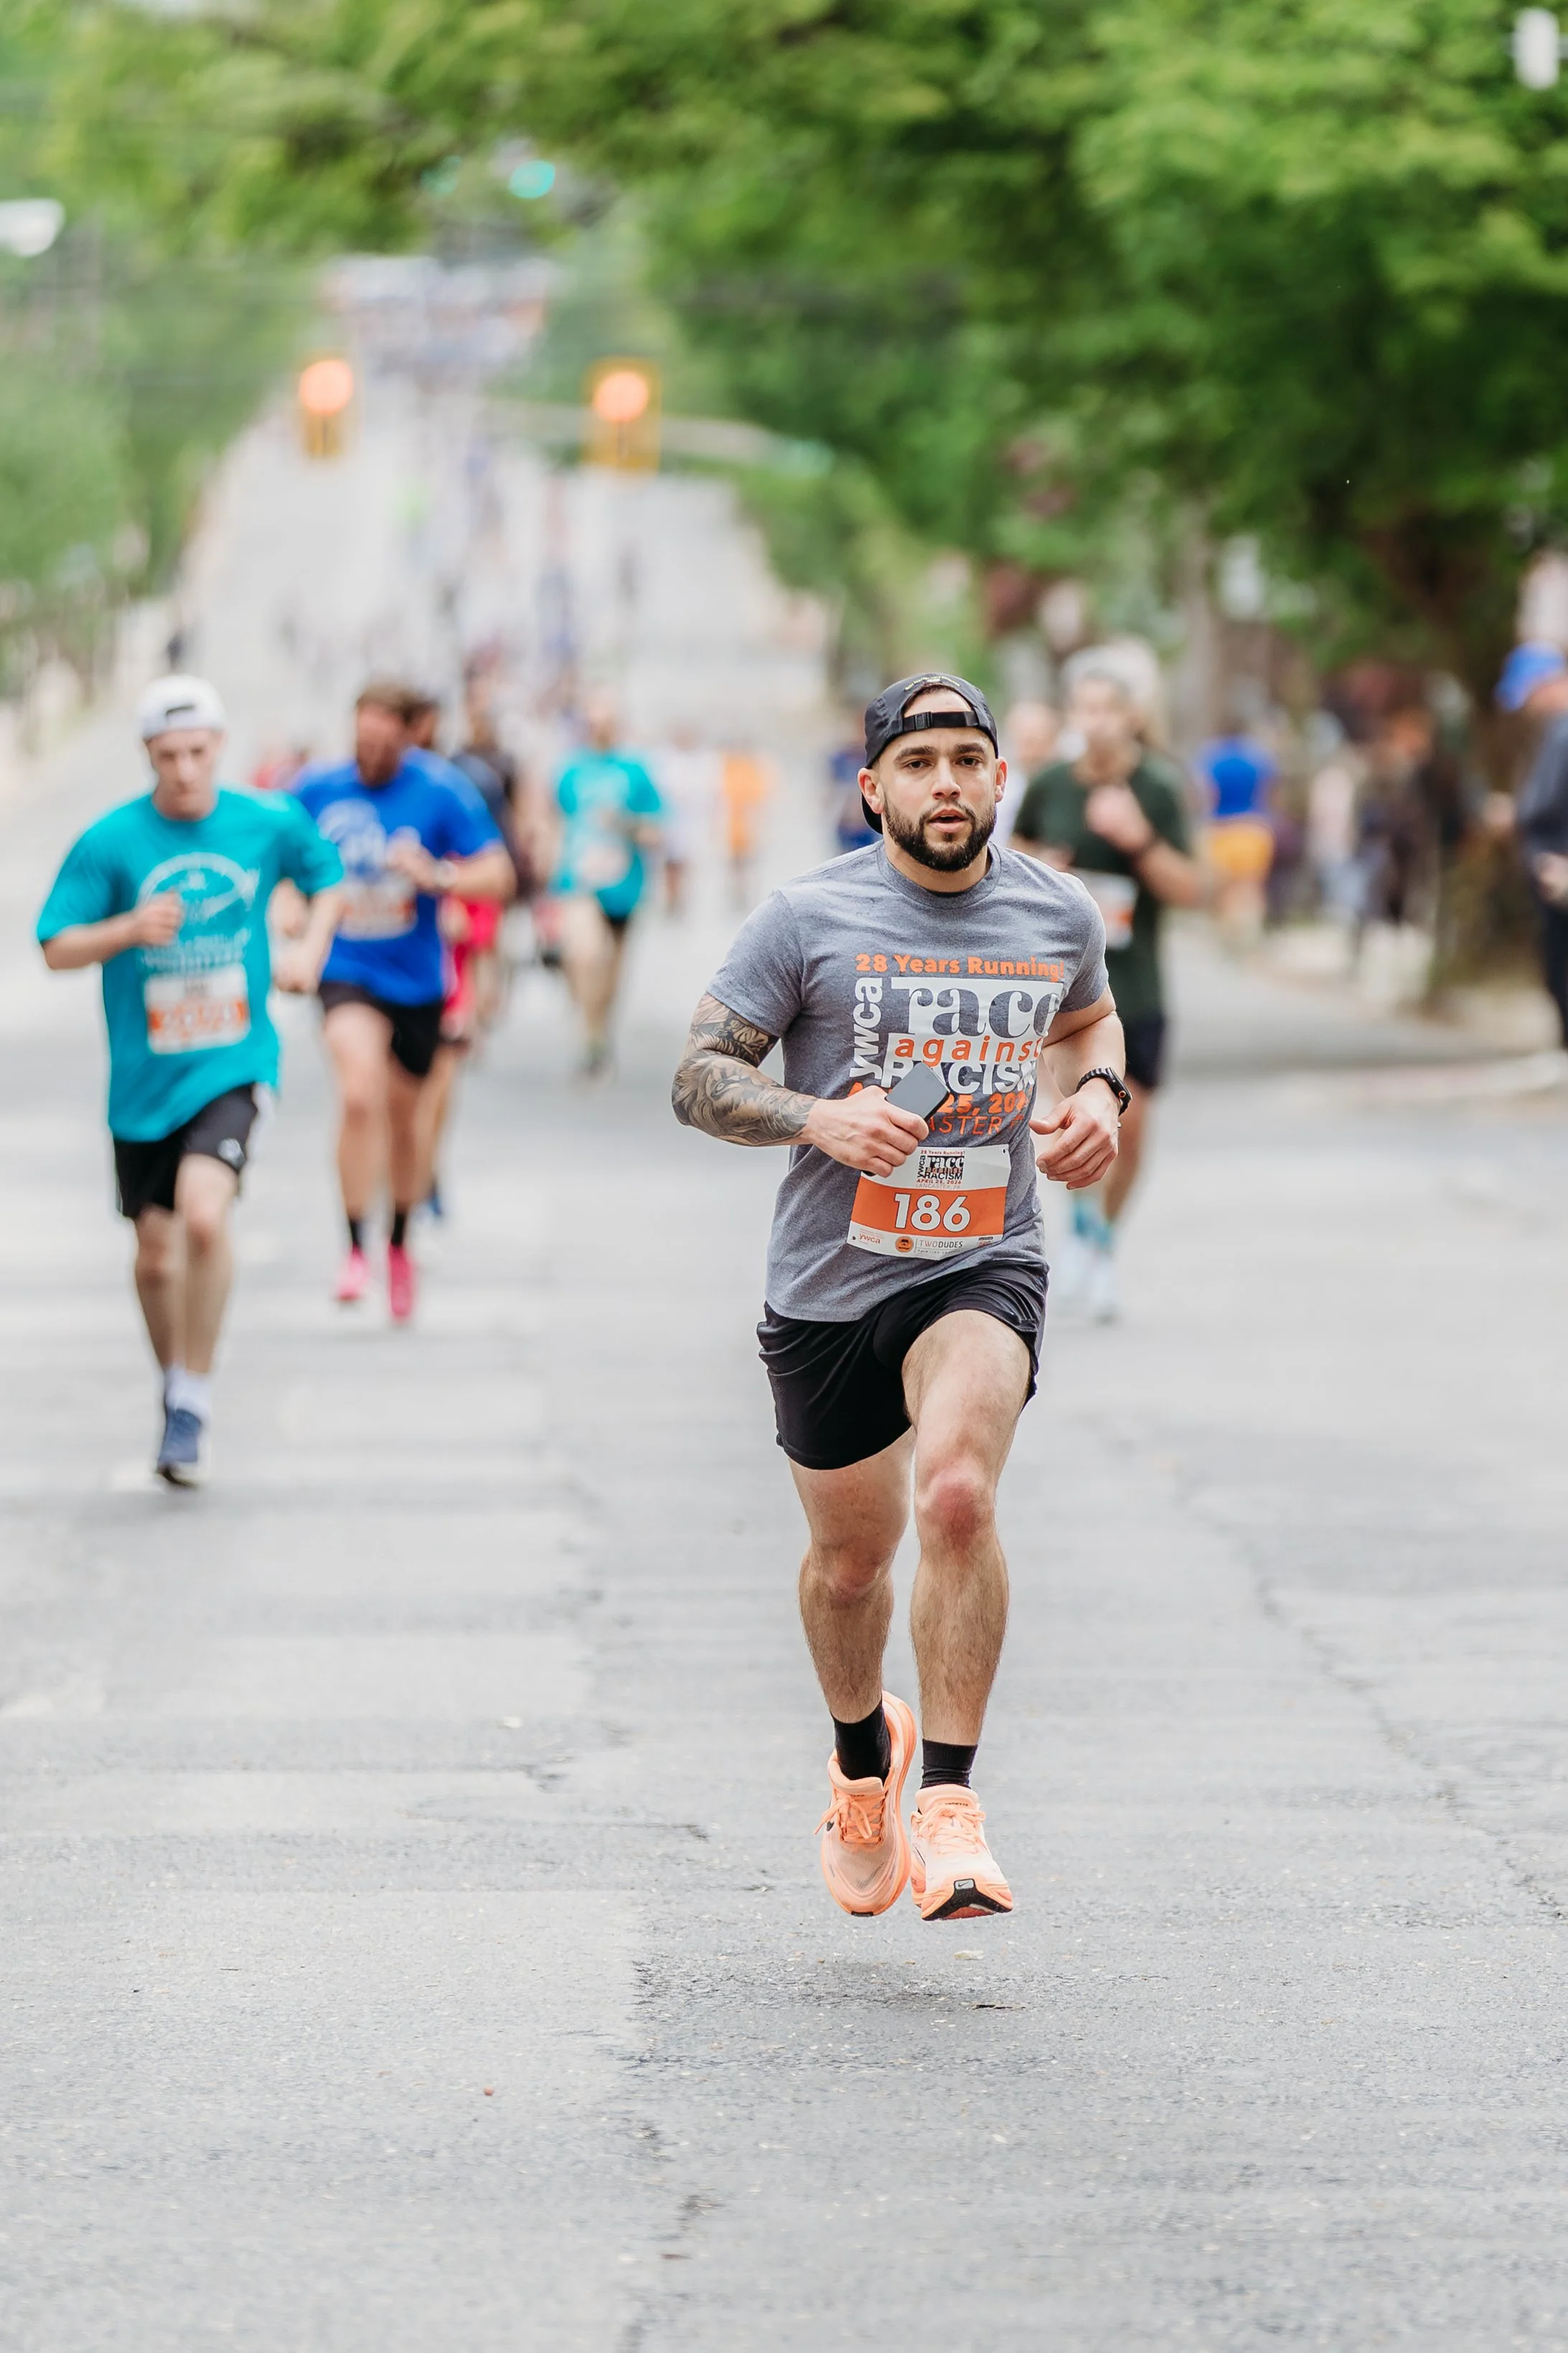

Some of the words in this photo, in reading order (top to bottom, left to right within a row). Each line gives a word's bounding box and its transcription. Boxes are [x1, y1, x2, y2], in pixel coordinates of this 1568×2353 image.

[855, 953, 888, 973] 28
[893, 953, 961, 974] Years
[967, 955, 1065, 982] Running!
[849, 977, 883, 1080] ywca
[917, 1156, 926, 1179] ywca
[927, 1156, 964, 1168] race
[924, 1169, 963, 1179] RACISM
[893, 1192, 971, 1232] 186
[859, 1233, 881, 1244] ywca
